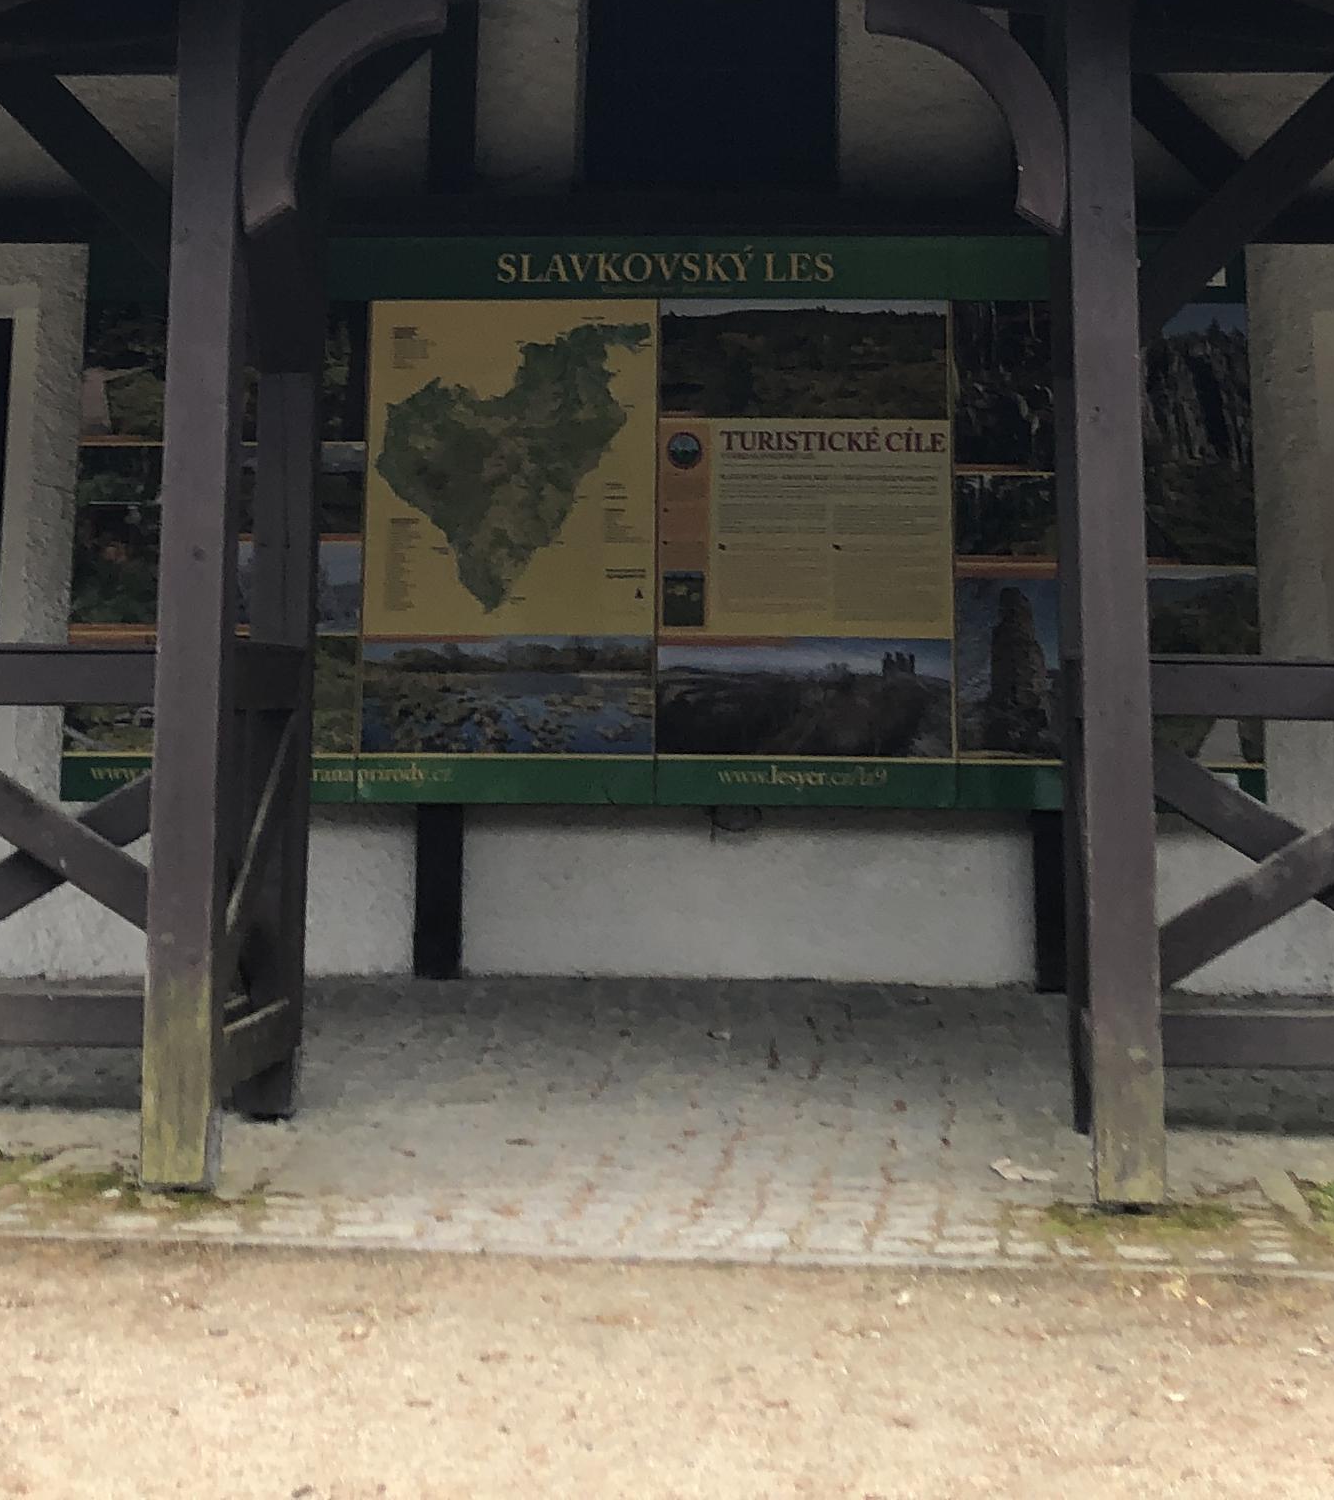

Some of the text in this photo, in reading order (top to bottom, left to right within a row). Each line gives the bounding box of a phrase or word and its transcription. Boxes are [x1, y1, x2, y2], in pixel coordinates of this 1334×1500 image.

[495, 245, 835, 284] SLAVKOVSKÝ LES
[720, 426, 947, 454] TURISTICKÉ CÍLE
